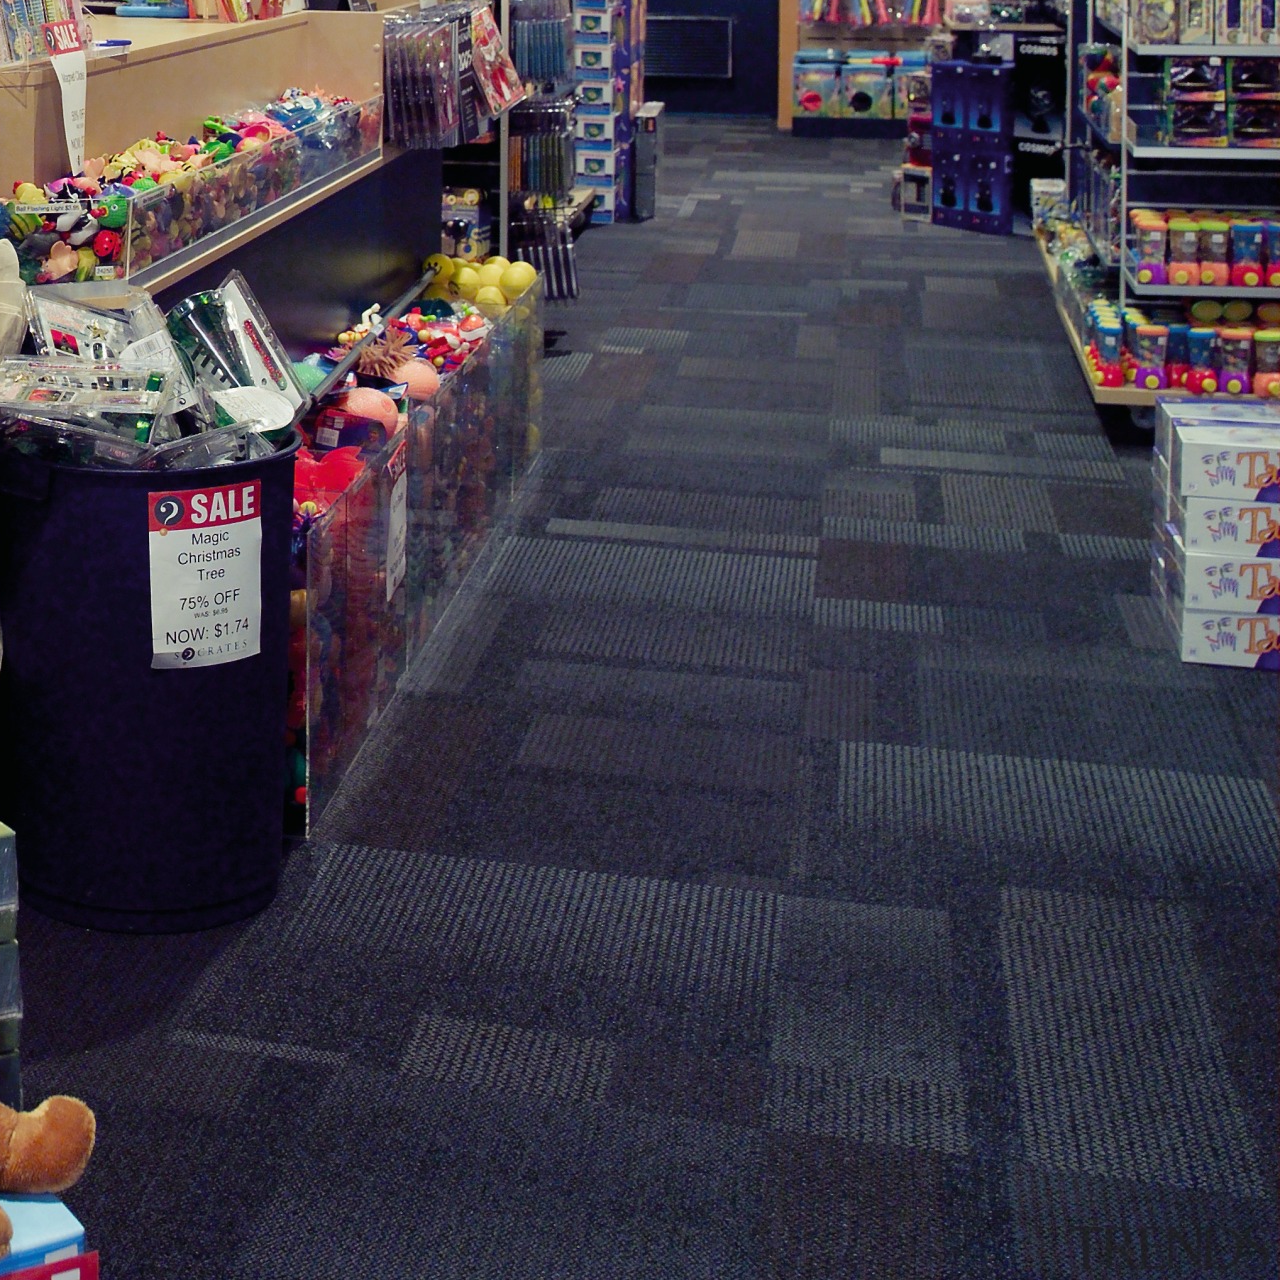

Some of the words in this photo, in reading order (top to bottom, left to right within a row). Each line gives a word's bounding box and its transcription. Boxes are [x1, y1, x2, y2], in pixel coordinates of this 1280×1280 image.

[54, 23, 80, 51] SALE
[1019, 44, 1058, 56] COSMOS
[1236, 451, 1280, 490] Ta
[191, 486, 255, 524] SALE
[191, 531, 230, 547] Magic
[1239, 507, 1280, 545] Ta
[178, 546, 241, 565] Christmas
[197, 567, 225, 581] Tree
[1239, 563, 1280, 601] Ta
[179, 597, 210, 611] 75%
[214, 588, 241, 605] OFF
[166, 626, 209, 645] NOW:
[214, 618, 249, 638] $1.74
[1237, 617, 1280, 655] Ta
